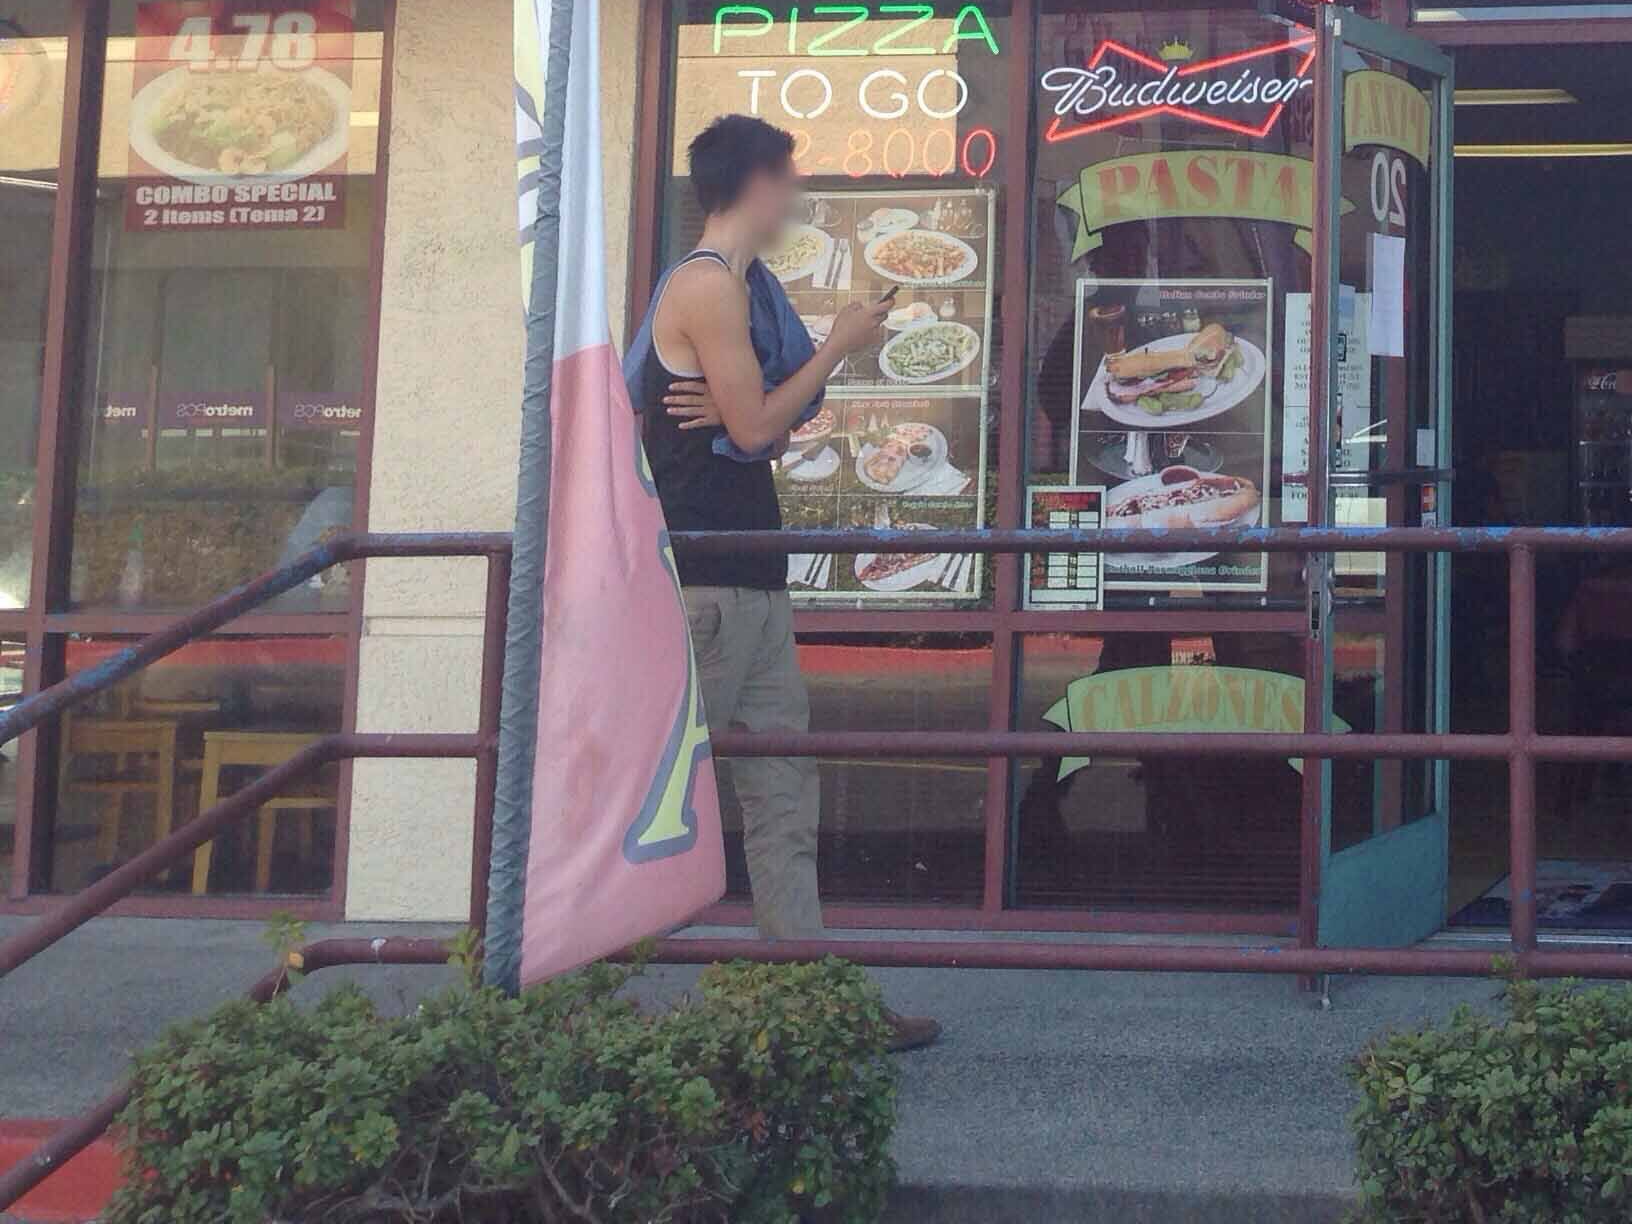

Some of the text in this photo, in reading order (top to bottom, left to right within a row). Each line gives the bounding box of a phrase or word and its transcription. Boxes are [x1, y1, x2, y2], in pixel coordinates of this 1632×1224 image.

[168, 10, 320, 75] 4.78
[711, 4, 1000, 57] PIZZA
[737, 68, 969, 120] TO GO
[1040, 65, 1314, 116] Budweiser
[135, 181, 337, 206] COMBO SPECIAL
[1096, 154, 1311, 220] PASTA
[142, 208, 159, 226] 2
[161, 208, 226, 225] Items
